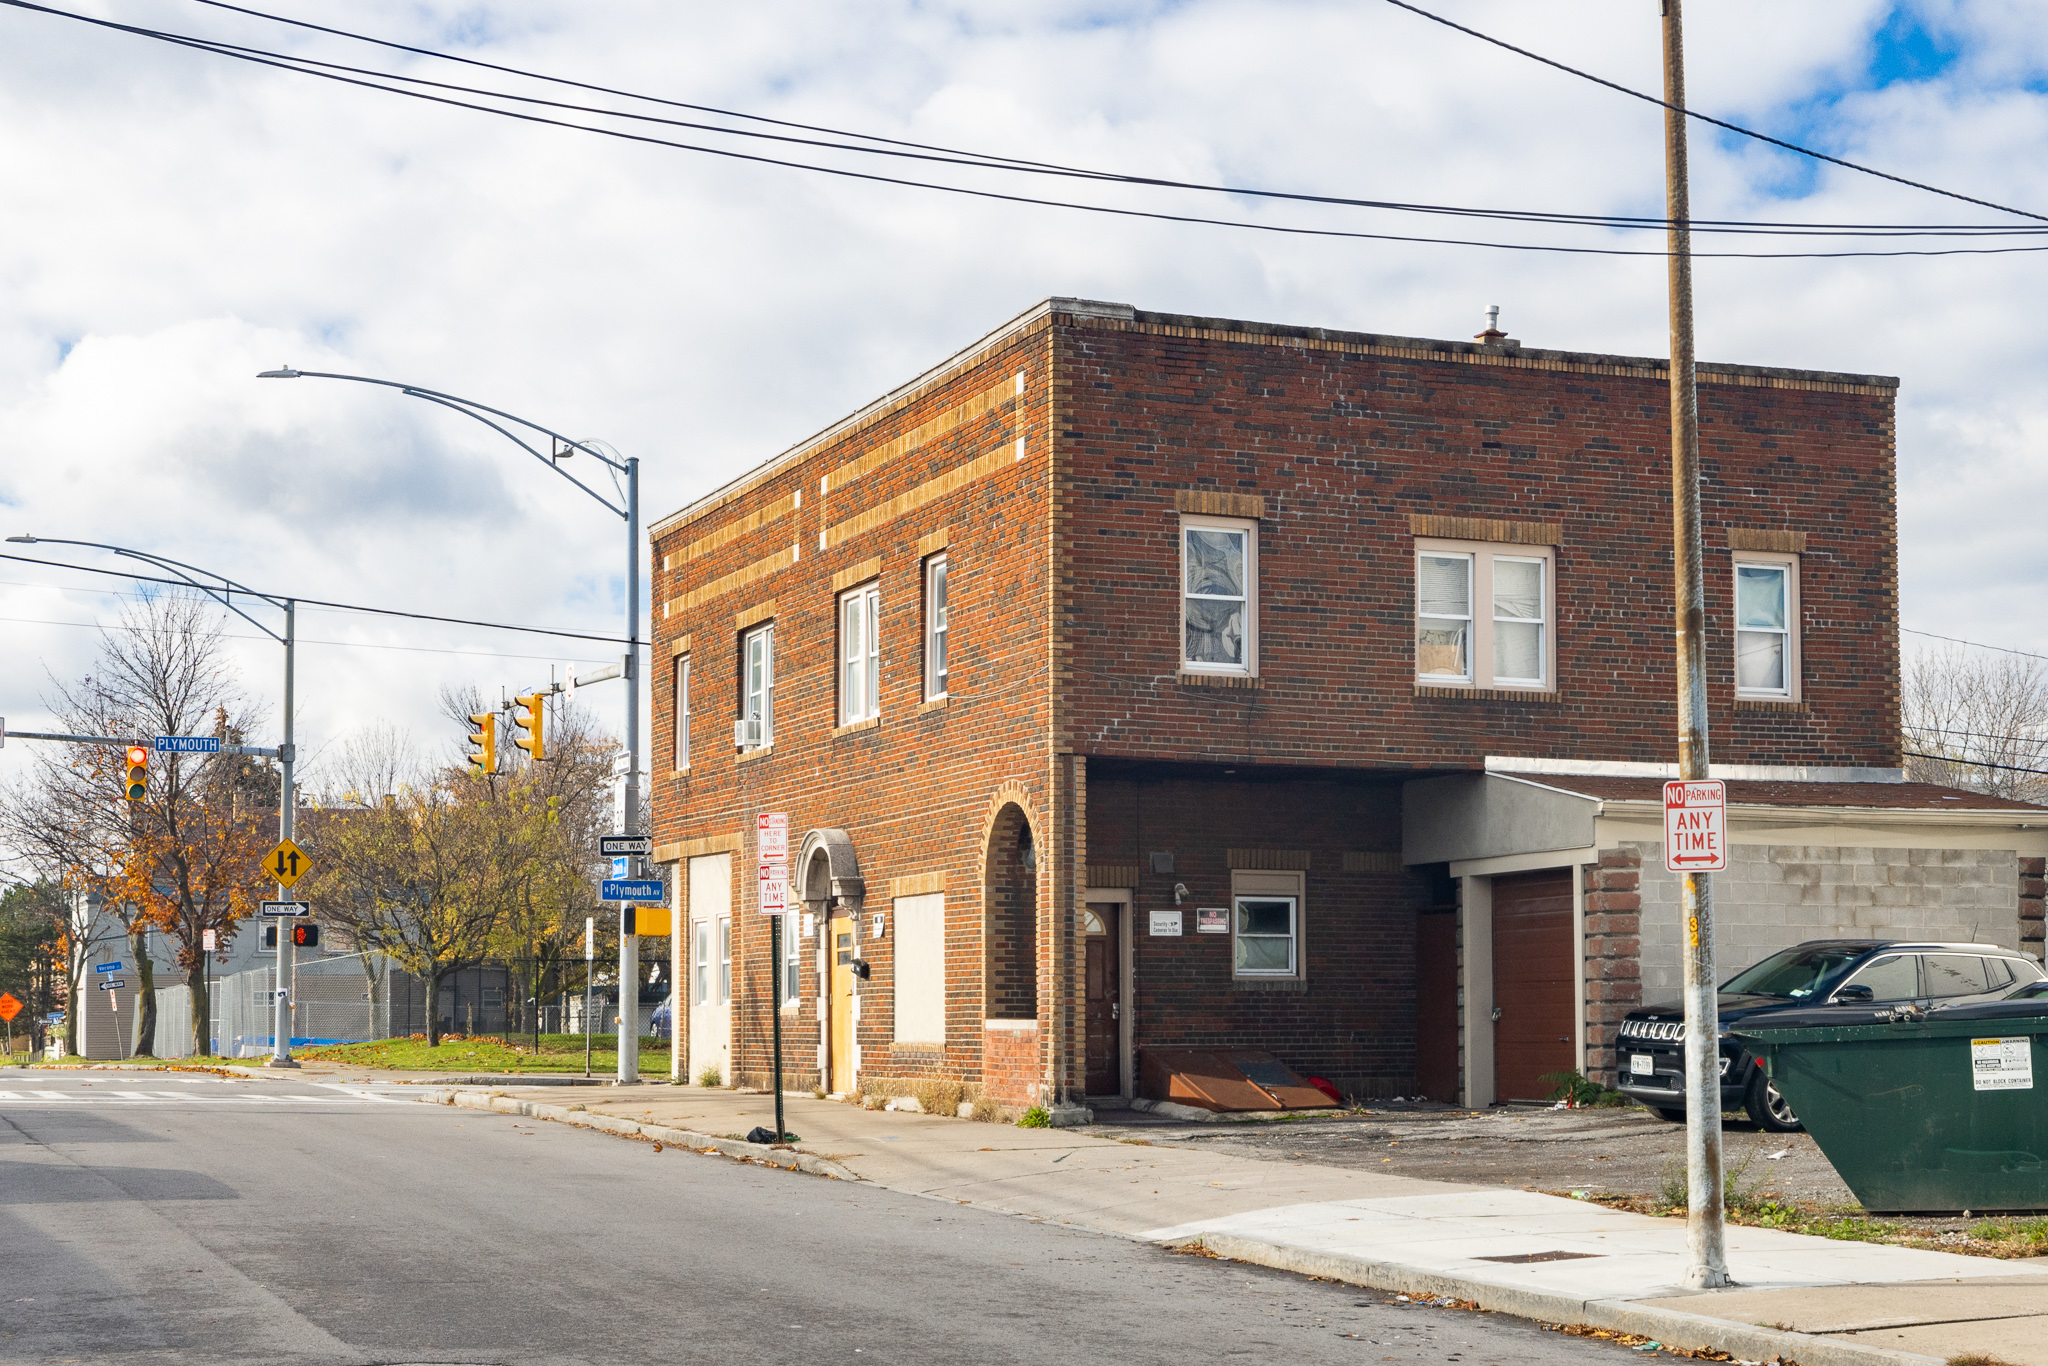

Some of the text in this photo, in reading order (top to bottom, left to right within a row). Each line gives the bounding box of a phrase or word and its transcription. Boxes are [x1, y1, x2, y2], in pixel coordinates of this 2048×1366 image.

[158, 739, 217, 751] PLYMOUTH
[1667, 786, 1721, 804] NO PARKING
[760, 817, 769, 827] NO
[1677, 811, 1713, 830] ANY
[605, 842, 648, 850] ONE WAY
[1674, 832, 1717, 850] TIME
[760, 868, 769, 878] NO
[610, 883, 652, 899] Plymouth
[766, 882, 782, 891] ANY
[764, 893, 785, 902] TIME
[1200, 917, 1226, 925] TRESPASSING
